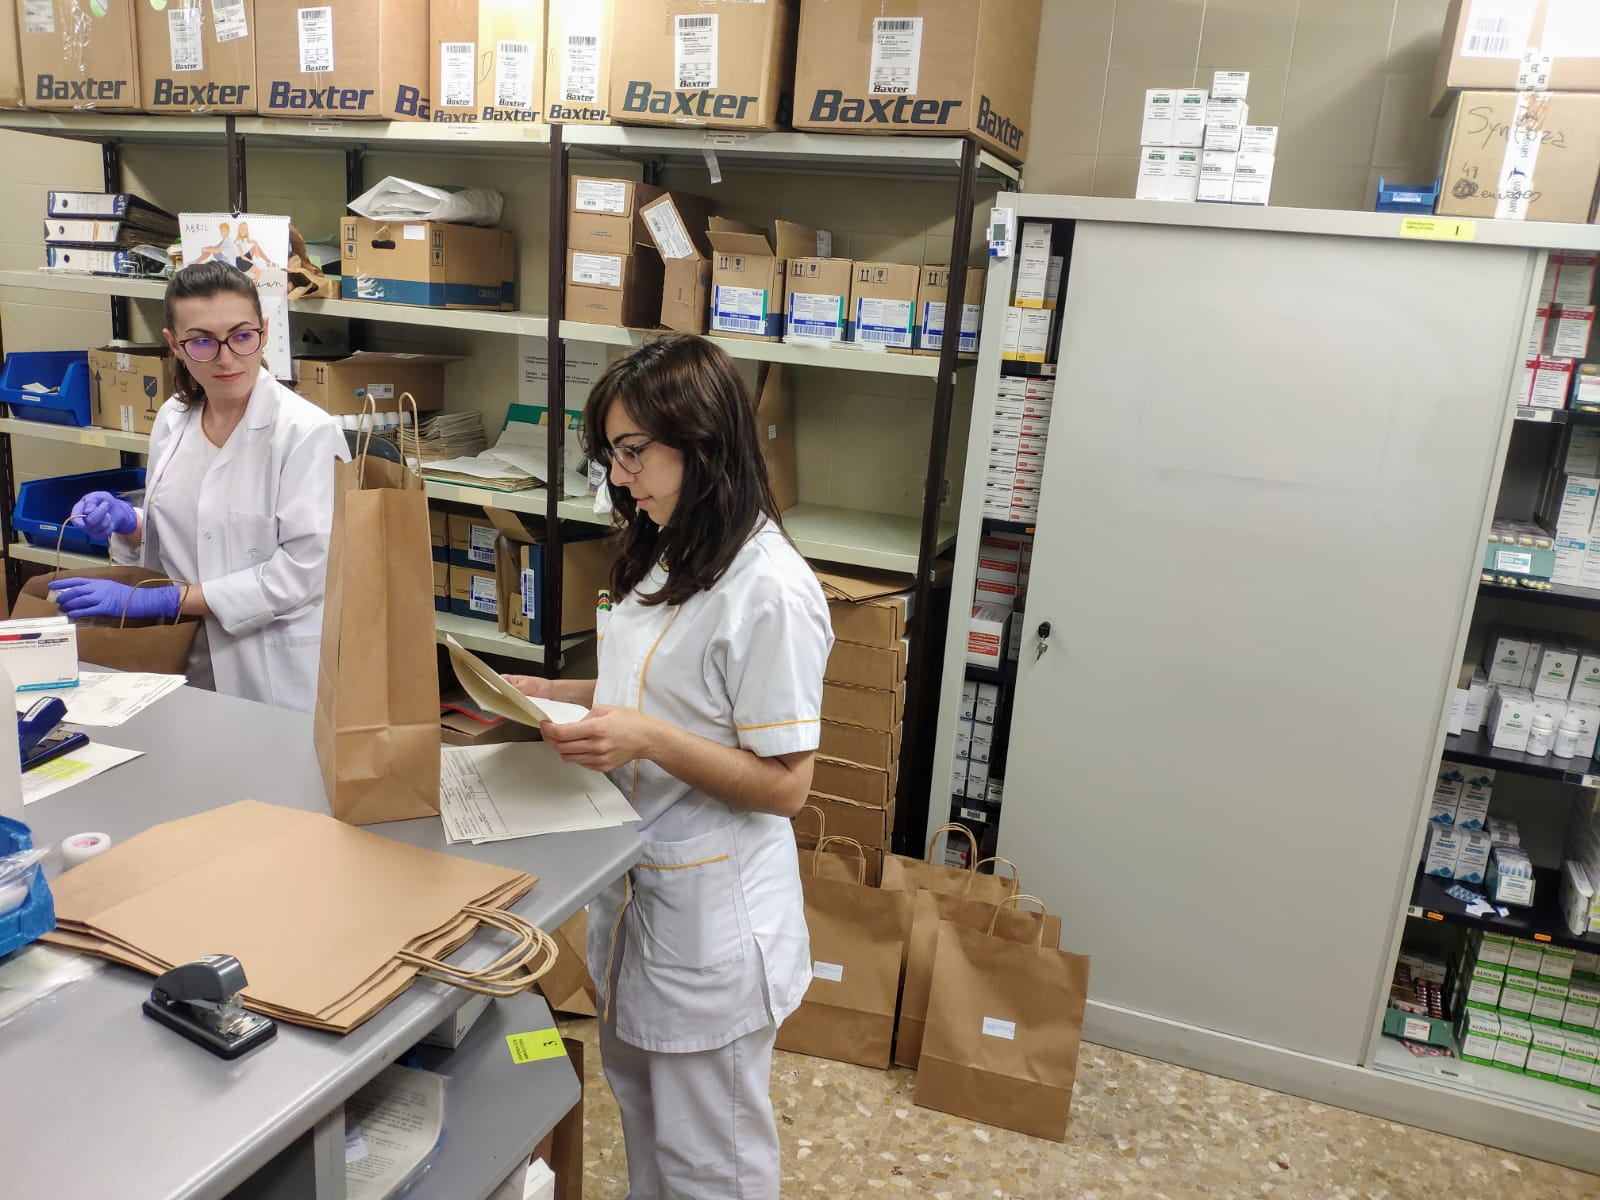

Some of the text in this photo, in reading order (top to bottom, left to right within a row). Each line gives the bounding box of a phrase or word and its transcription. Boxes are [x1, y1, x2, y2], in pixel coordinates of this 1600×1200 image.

[305, 64, 330, 72] Baxter
[36, 74, 127, 100] Baxter
[679, 80, 710, 88] Baxter
[873, 85, 910, 93] Baxter
[154, 79, 250, 106] Baxter
[269, 81, 374, 110] Baxter
[565, 93, 594, 102] Baxter
[446, 98, 471, 106] Baxter
[498, 98, 527, 108] Baxter
[622, 80, 757, 119] Baxter
[809, 89, 962, 125] Baxter
[433, 110, 478, 123] Baxte
[482, 106, 540, 122] Baxter
[976, 94, 1024, 151] Baxter
[185, 222, 210, 233] ABRIL
